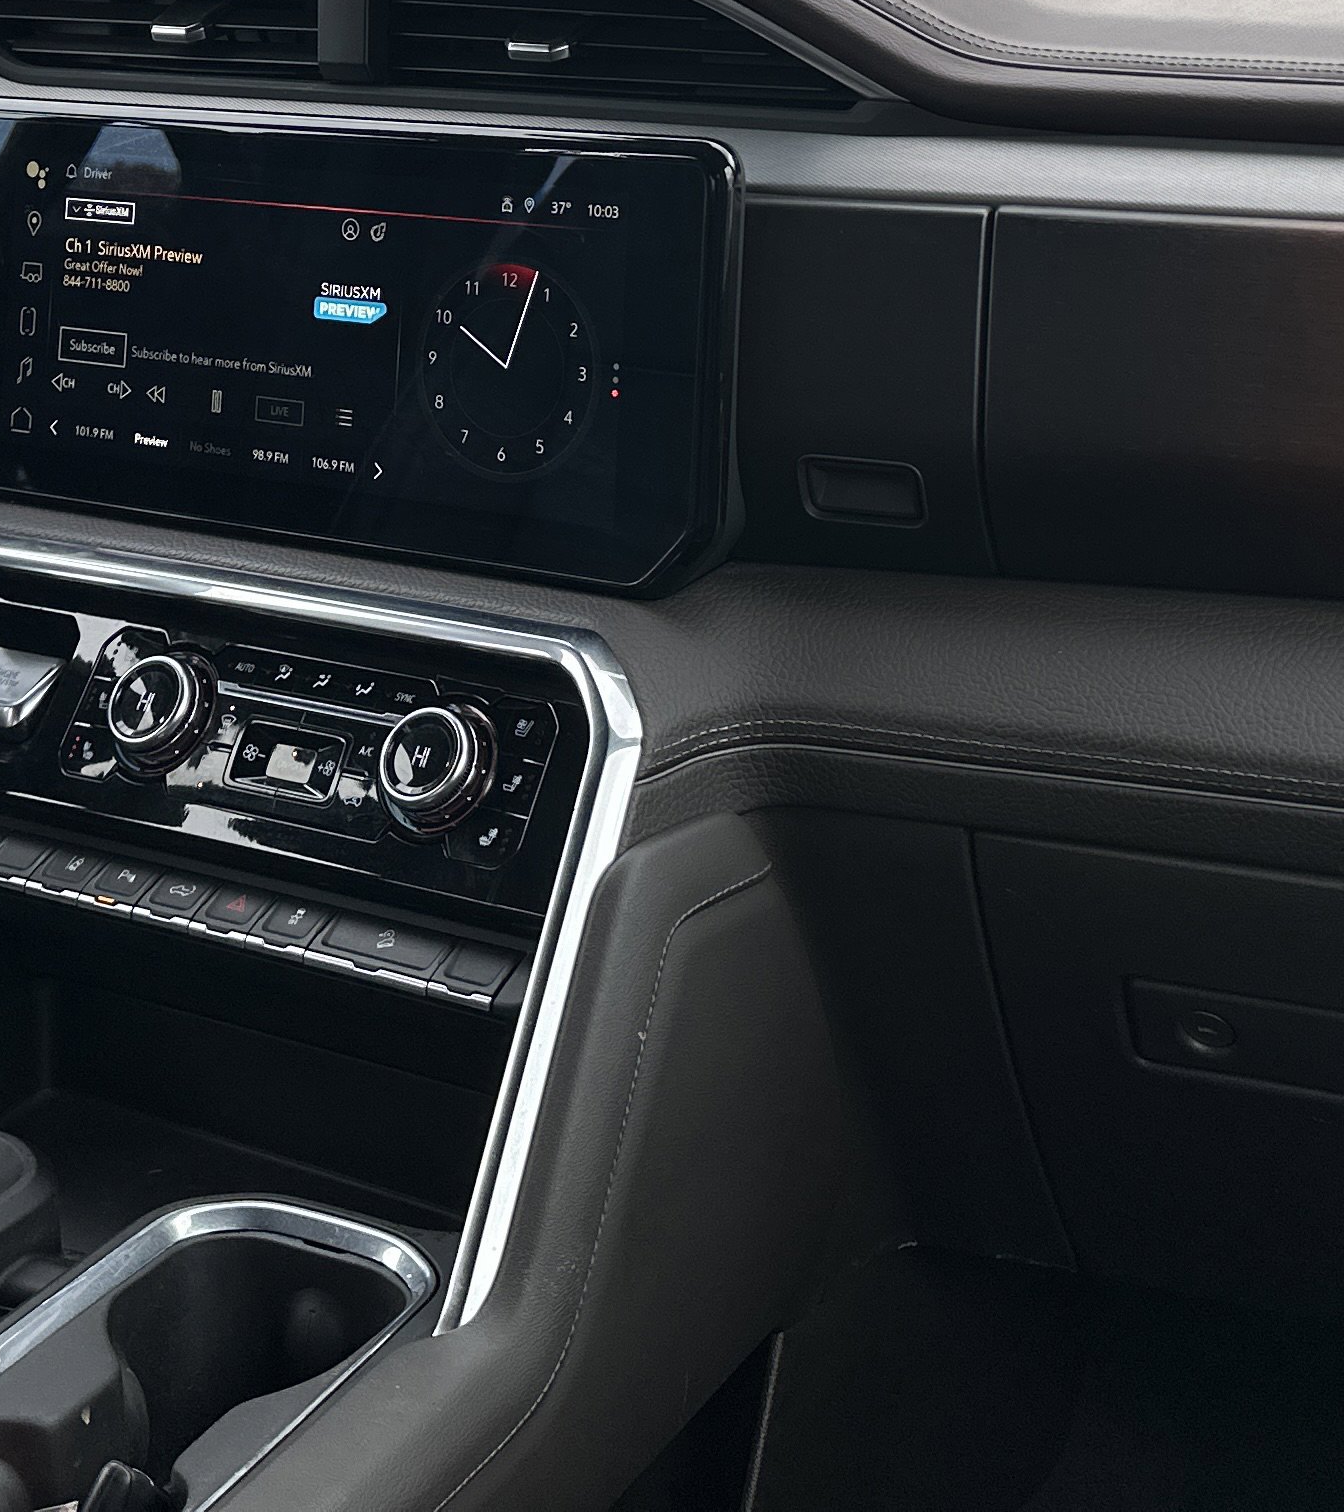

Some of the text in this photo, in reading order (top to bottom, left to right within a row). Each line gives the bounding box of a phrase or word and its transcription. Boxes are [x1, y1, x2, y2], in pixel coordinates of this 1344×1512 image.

[83, 166, 112, 180] Driver
[95, 204, 130, 218] SiriusXM
[587, 203, 619, 219] 10:03
[65, 237, 204, 265] Ch 1 SiriusXM Preview
[64, 258, 144, 277] Great Offer Now!
[62, 274, 131, 293] 844-711-8800
[464, 280, 480, 296] 11
[502, 272, 519, 289] 12
[320, 281, 381, 300] SIRIUSXM
[543, 287, 551, 303] 1
[318, 301, 381, 320] PREVIEW
[435, 308, 453, 325] 10
[569, 322, 579, 339] 2
[69, 339, 116, 356] Subscribe
[131, 345, 313, 378] Subscribe to hear more from SiriusXM
[427, 350, 438, 366] 9
[62, 377, 76, 389] CH
[577, 366, 587, 383] 3
[434, 394, 445, 410] 8
[270, 404, 290, 418] LIVE
[562, 410, 574, 426] 4
[75, 424, 115, 441] 101.9 FM
[133, 431, 169, 449] Preview
[460, 429, 470, 445] 7
[189, 440, 232, 458] No Shoes
[496, 447, 507, 463] 6
[535, 439, 546, 455] 5
[251, 448, 290, 465] 98.9 FM
[311, 456, 355, 474] 106.9 FM
[394, 691, 417, 705] SYNC
